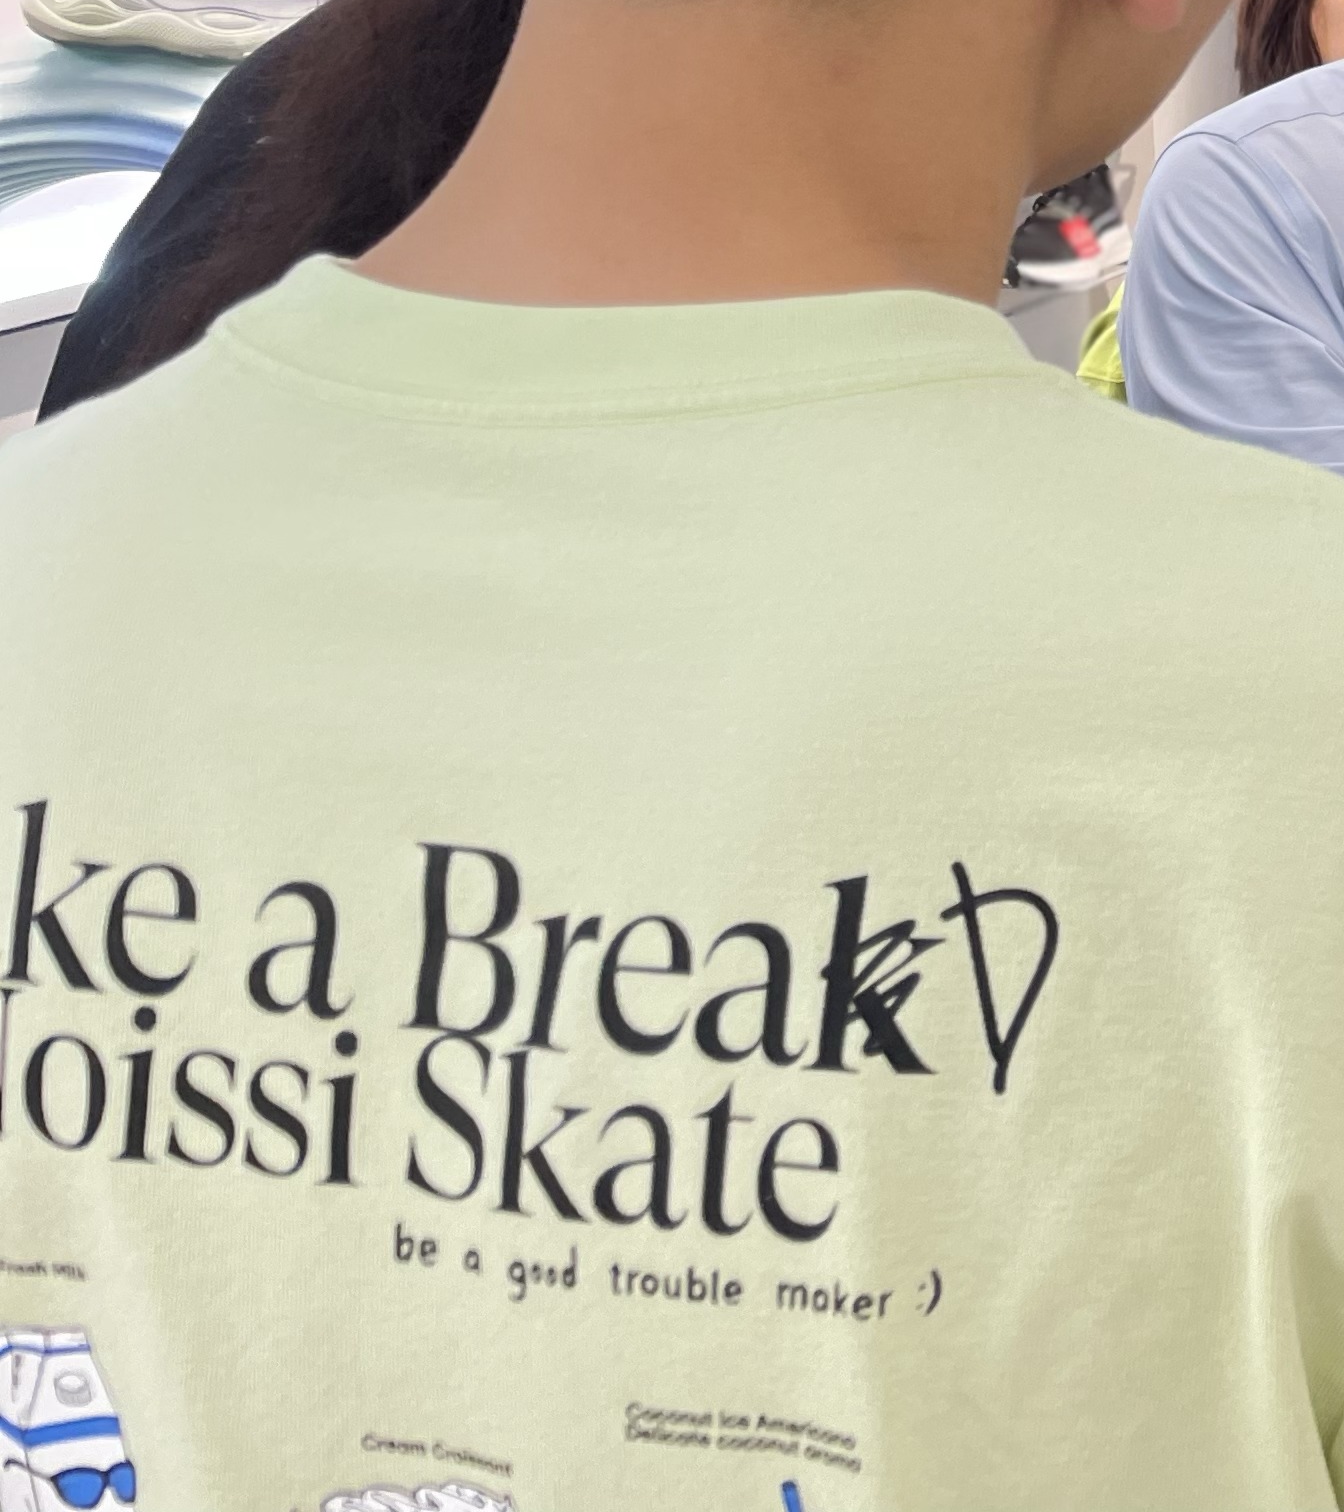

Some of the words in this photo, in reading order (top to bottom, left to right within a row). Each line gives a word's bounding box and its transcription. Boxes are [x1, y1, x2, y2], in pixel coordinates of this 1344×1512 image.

[246, 880, 354, 1020] a
[0, 988, 364, 1188] oissi
[404, 1032, 844, 1242] Skate
[395, 1222, 439, 1265] be
[464, 1248, 482, 1271] a
[509, 1246, 580, 1303] good
[611, 1263, 744, 1305] trouble
[361, 1433, 427, 1456] Cream
